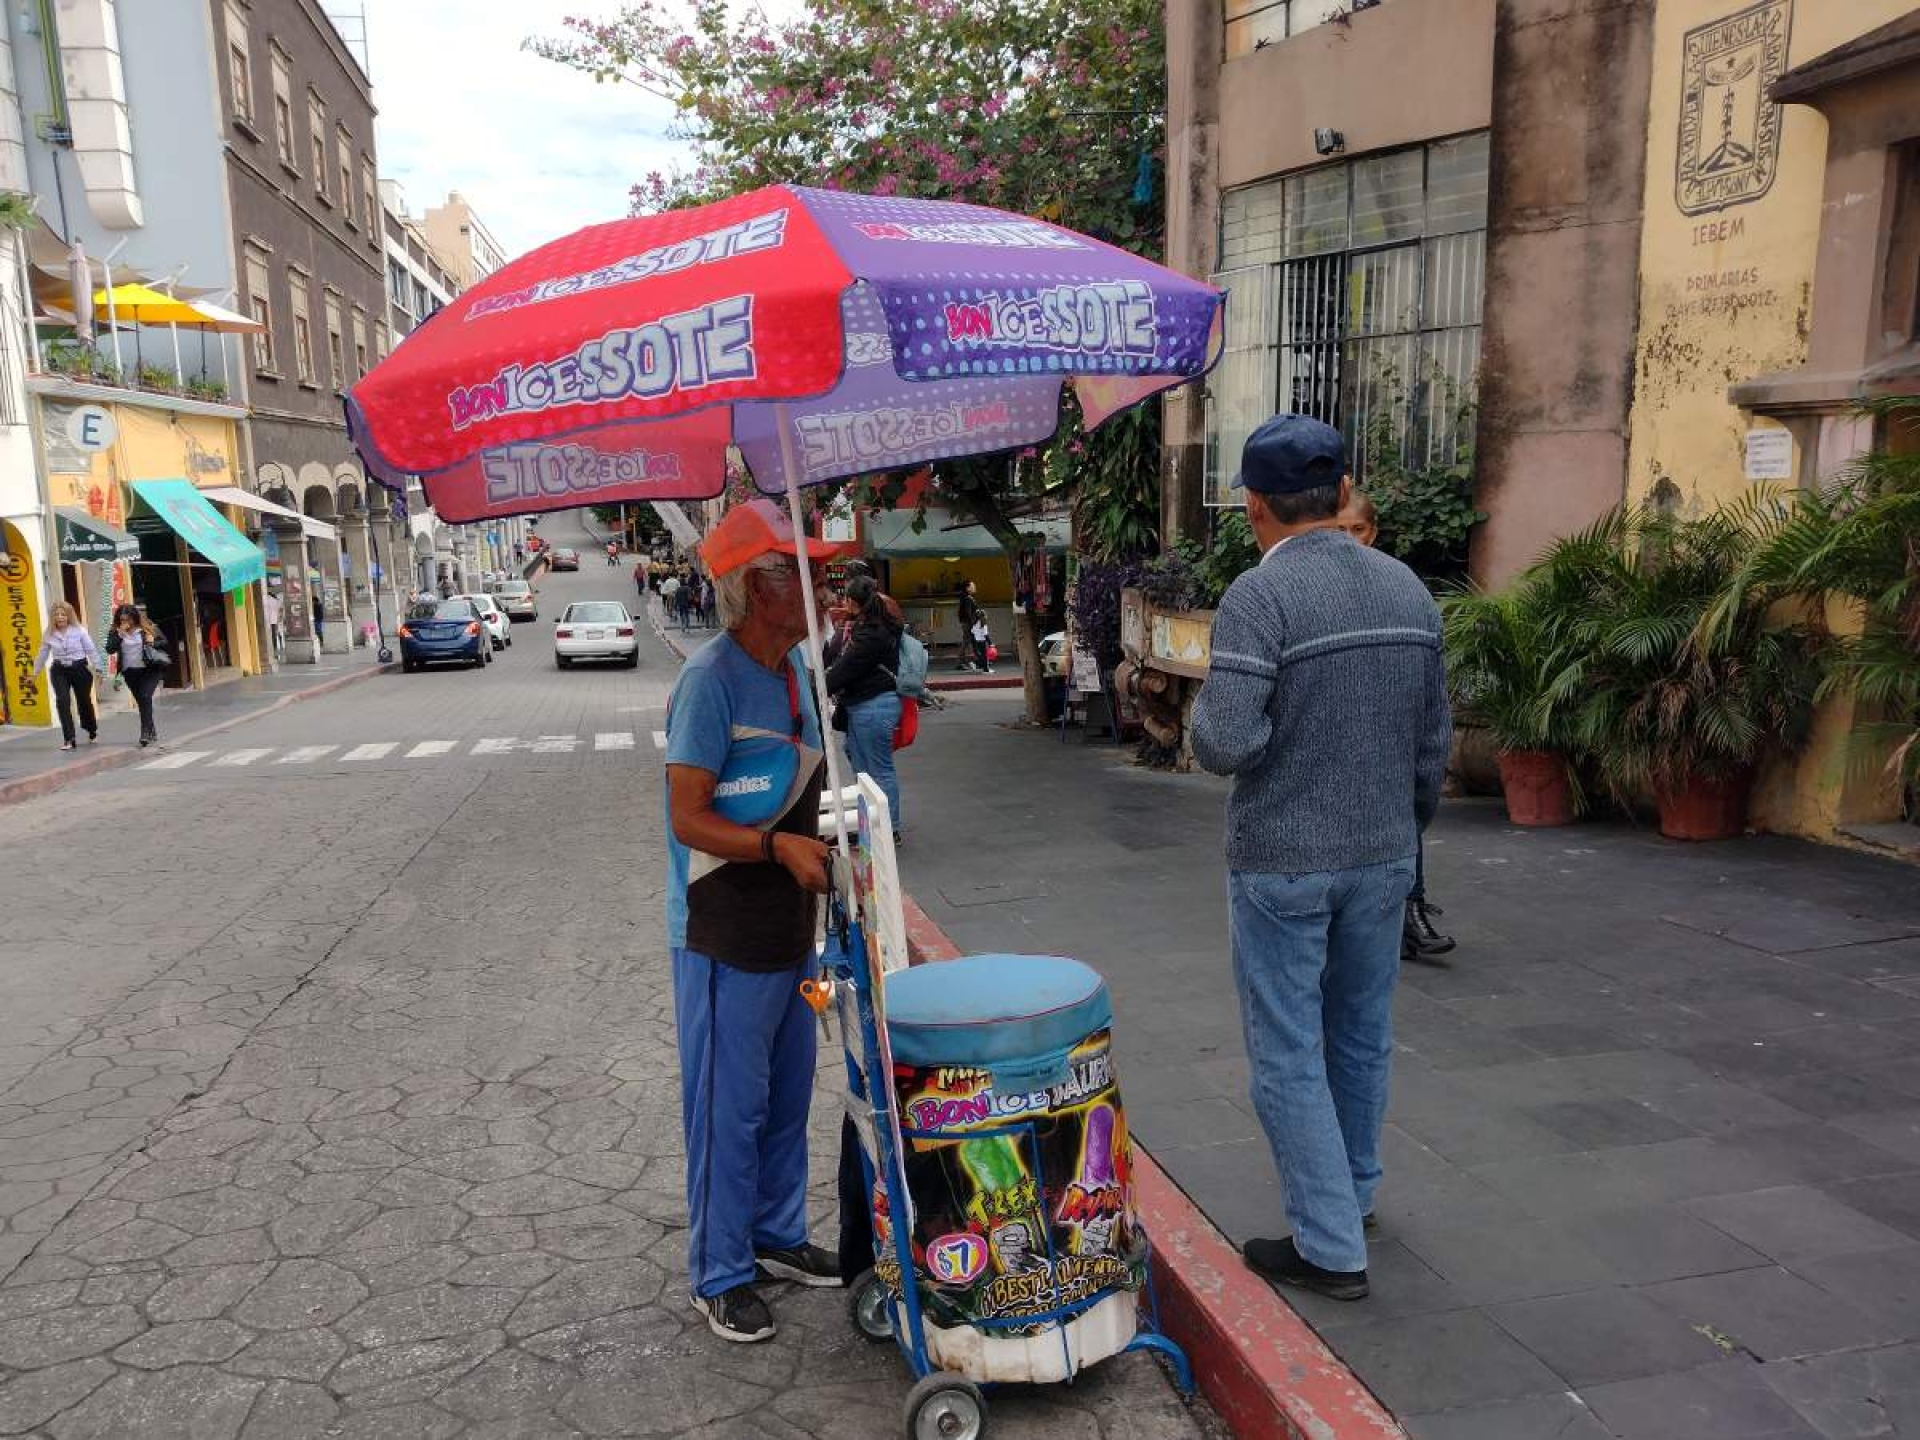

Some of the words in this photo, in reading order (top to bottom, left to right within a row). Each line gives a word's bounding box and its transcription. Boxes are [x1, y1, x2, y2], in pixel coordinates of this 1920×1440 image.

[1692, 217, 1745, 247] IEBEM
[82, 413, 102, 446] E
[937, 1240, 970, 1277] $7
